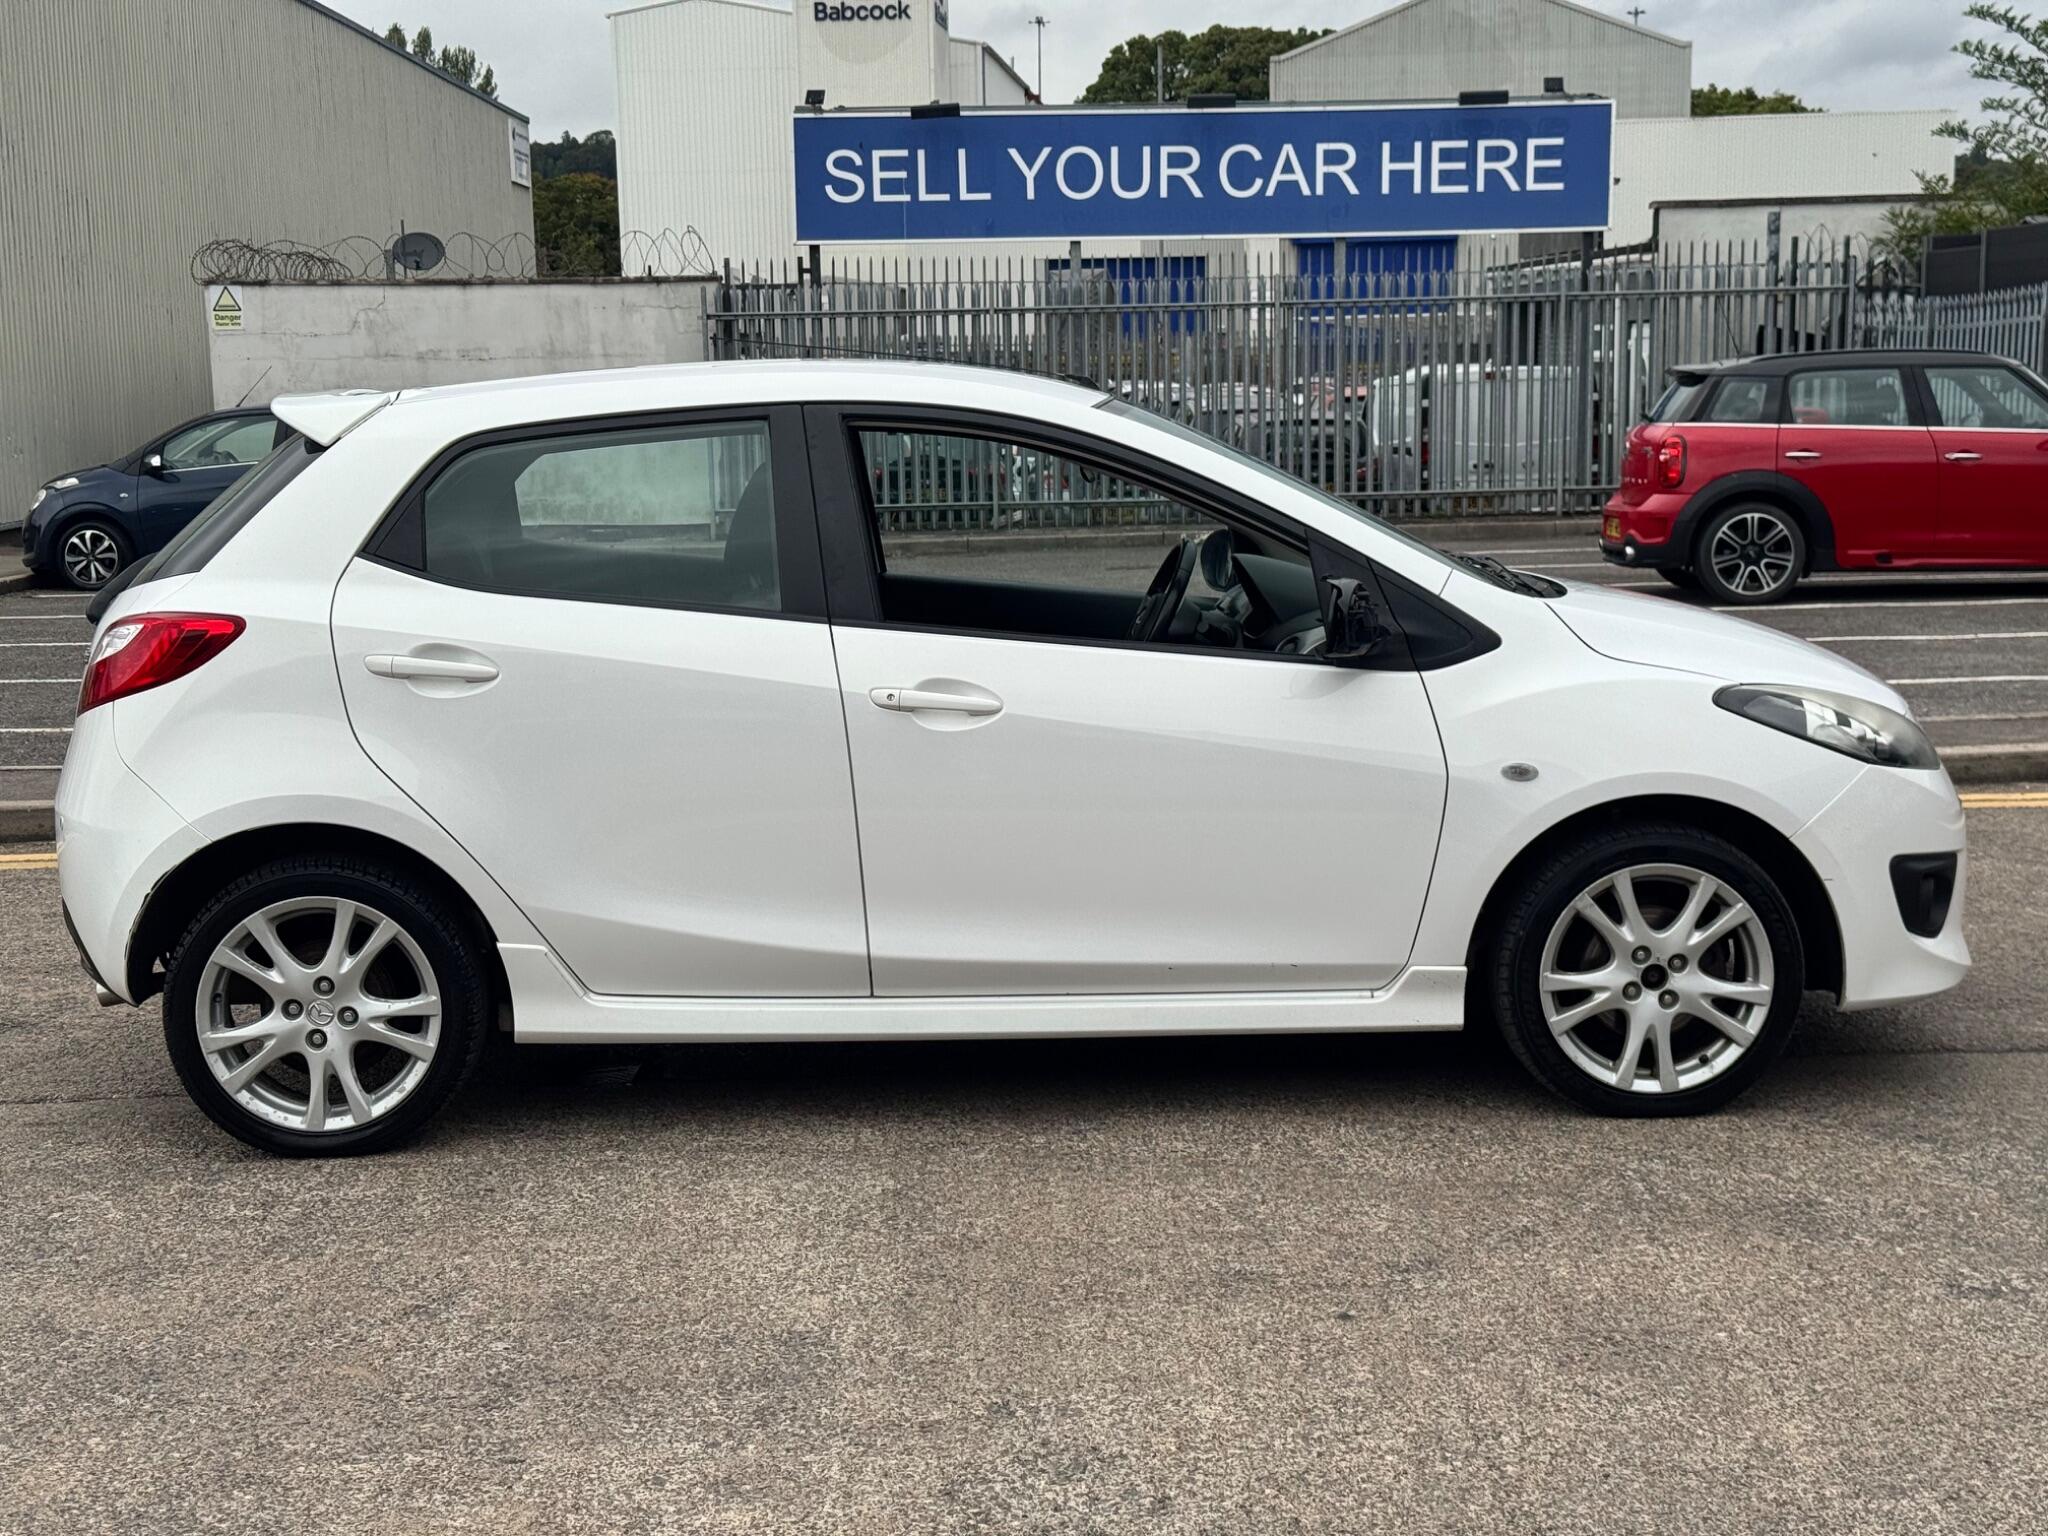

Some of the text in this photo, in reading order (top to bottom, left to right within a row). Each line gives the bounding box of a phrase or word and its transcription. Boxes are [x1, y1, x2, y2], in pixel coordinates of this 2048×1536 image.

[814, 0, 911, 21] Babcock
[825, 137, 1565, 203] SELL YOUR CAR HERE
[214, 314, 241, 322] Danger
